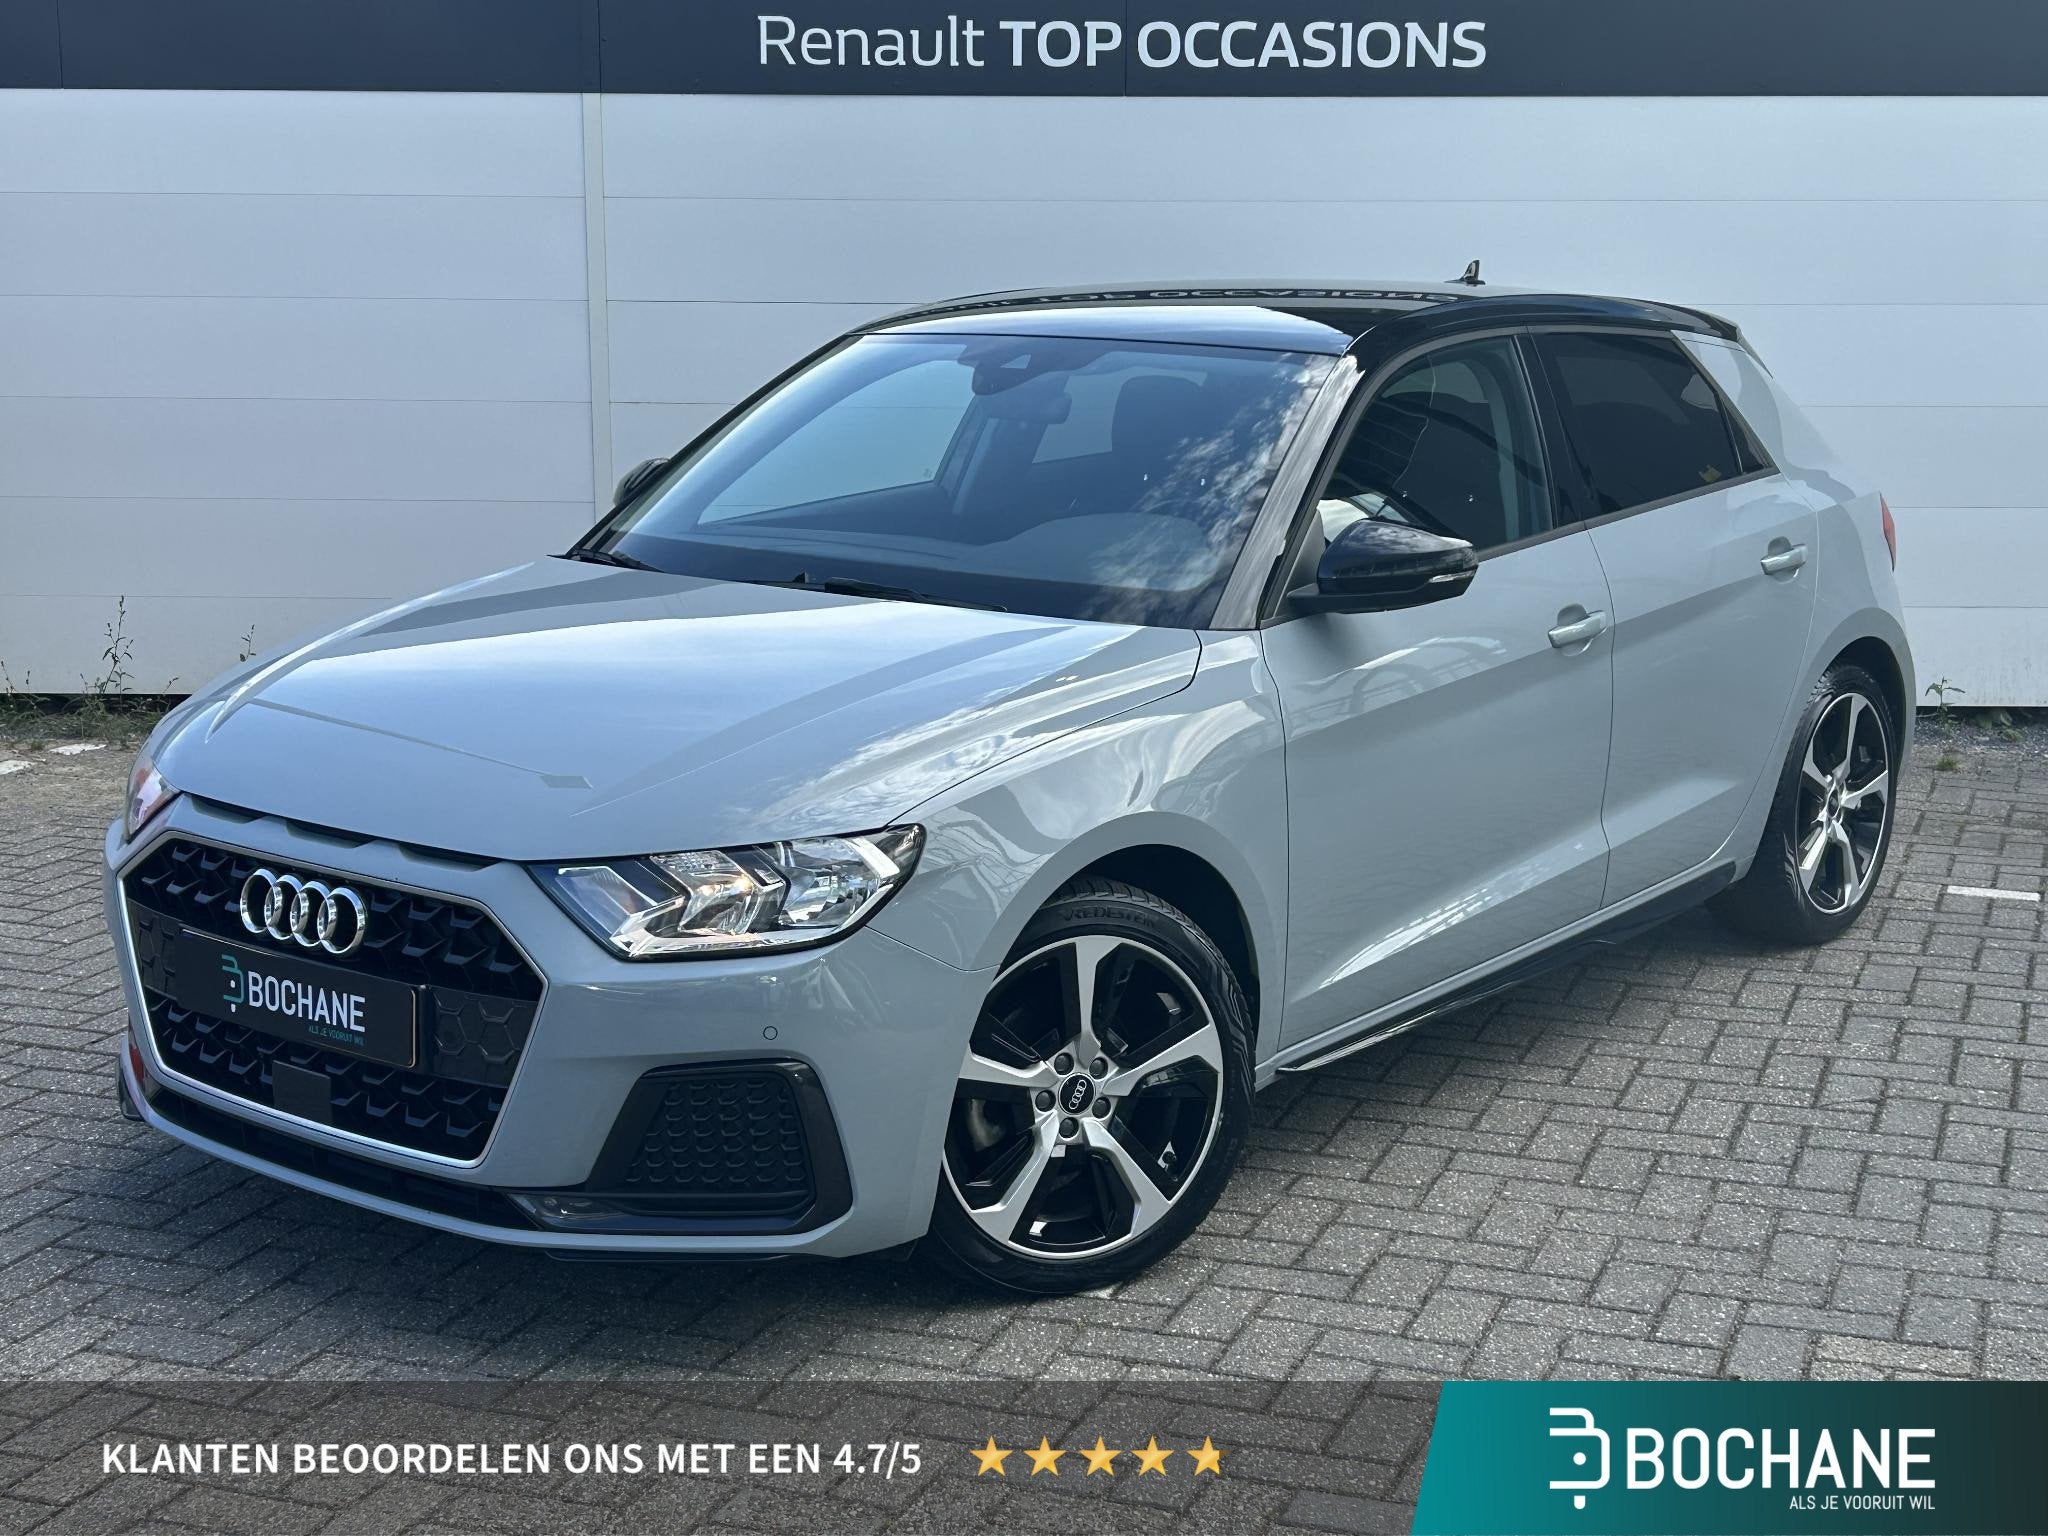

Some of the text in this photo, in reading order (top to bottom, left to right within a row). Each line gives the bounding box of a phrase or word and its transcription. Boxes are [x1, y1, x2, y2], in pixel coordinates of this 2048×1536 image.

[757, 14, 1487, 69] Renault TOP OCCASIONS
[247, 970, 366, 1033] BOCHANE
